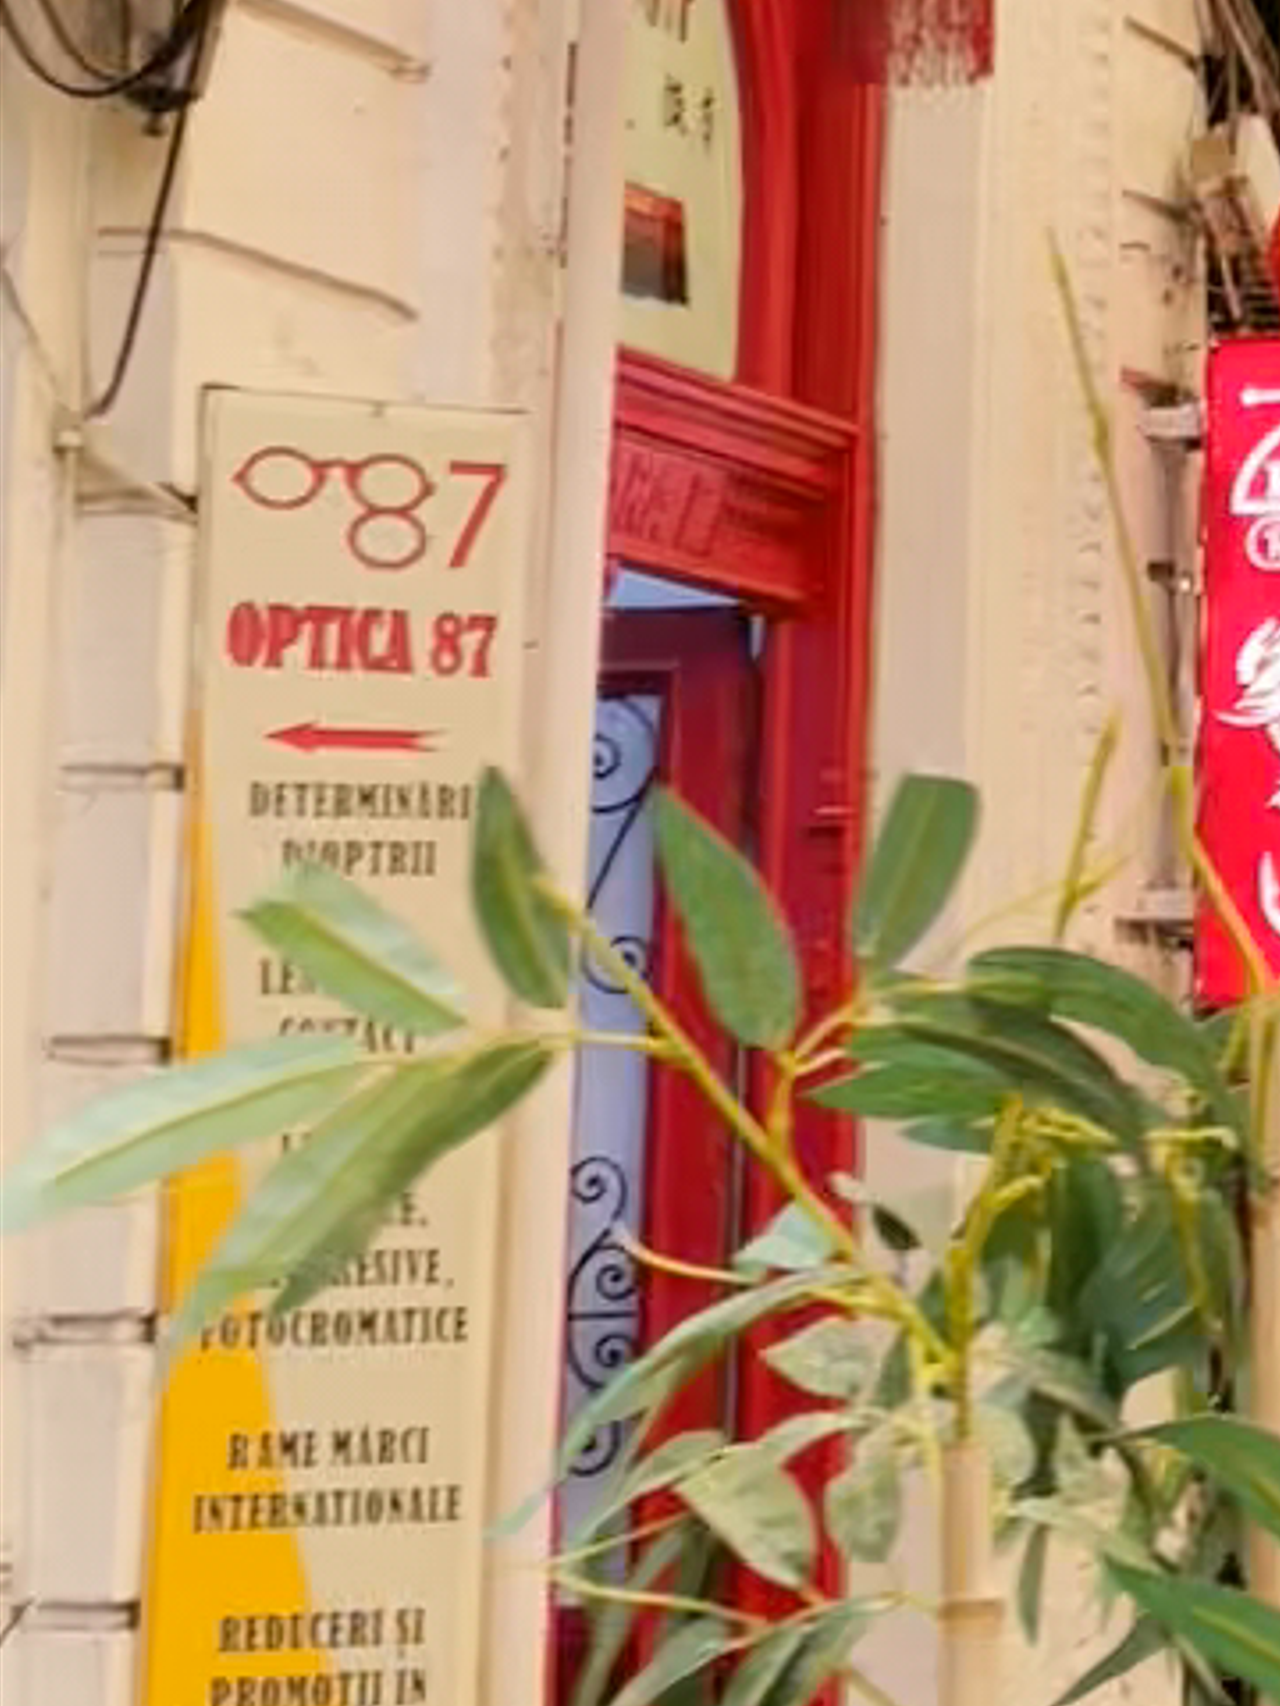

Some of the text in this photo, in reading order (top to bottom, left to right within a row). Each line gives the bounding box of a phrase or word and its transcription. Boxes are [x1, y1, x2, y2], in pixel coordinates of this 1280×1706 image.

[228, 600, 498, 678] OPTICA 87
[192, 1484, 462, 1534] INTERNATIONALE
[217, 1611, 384, 1653] REDUCERI
